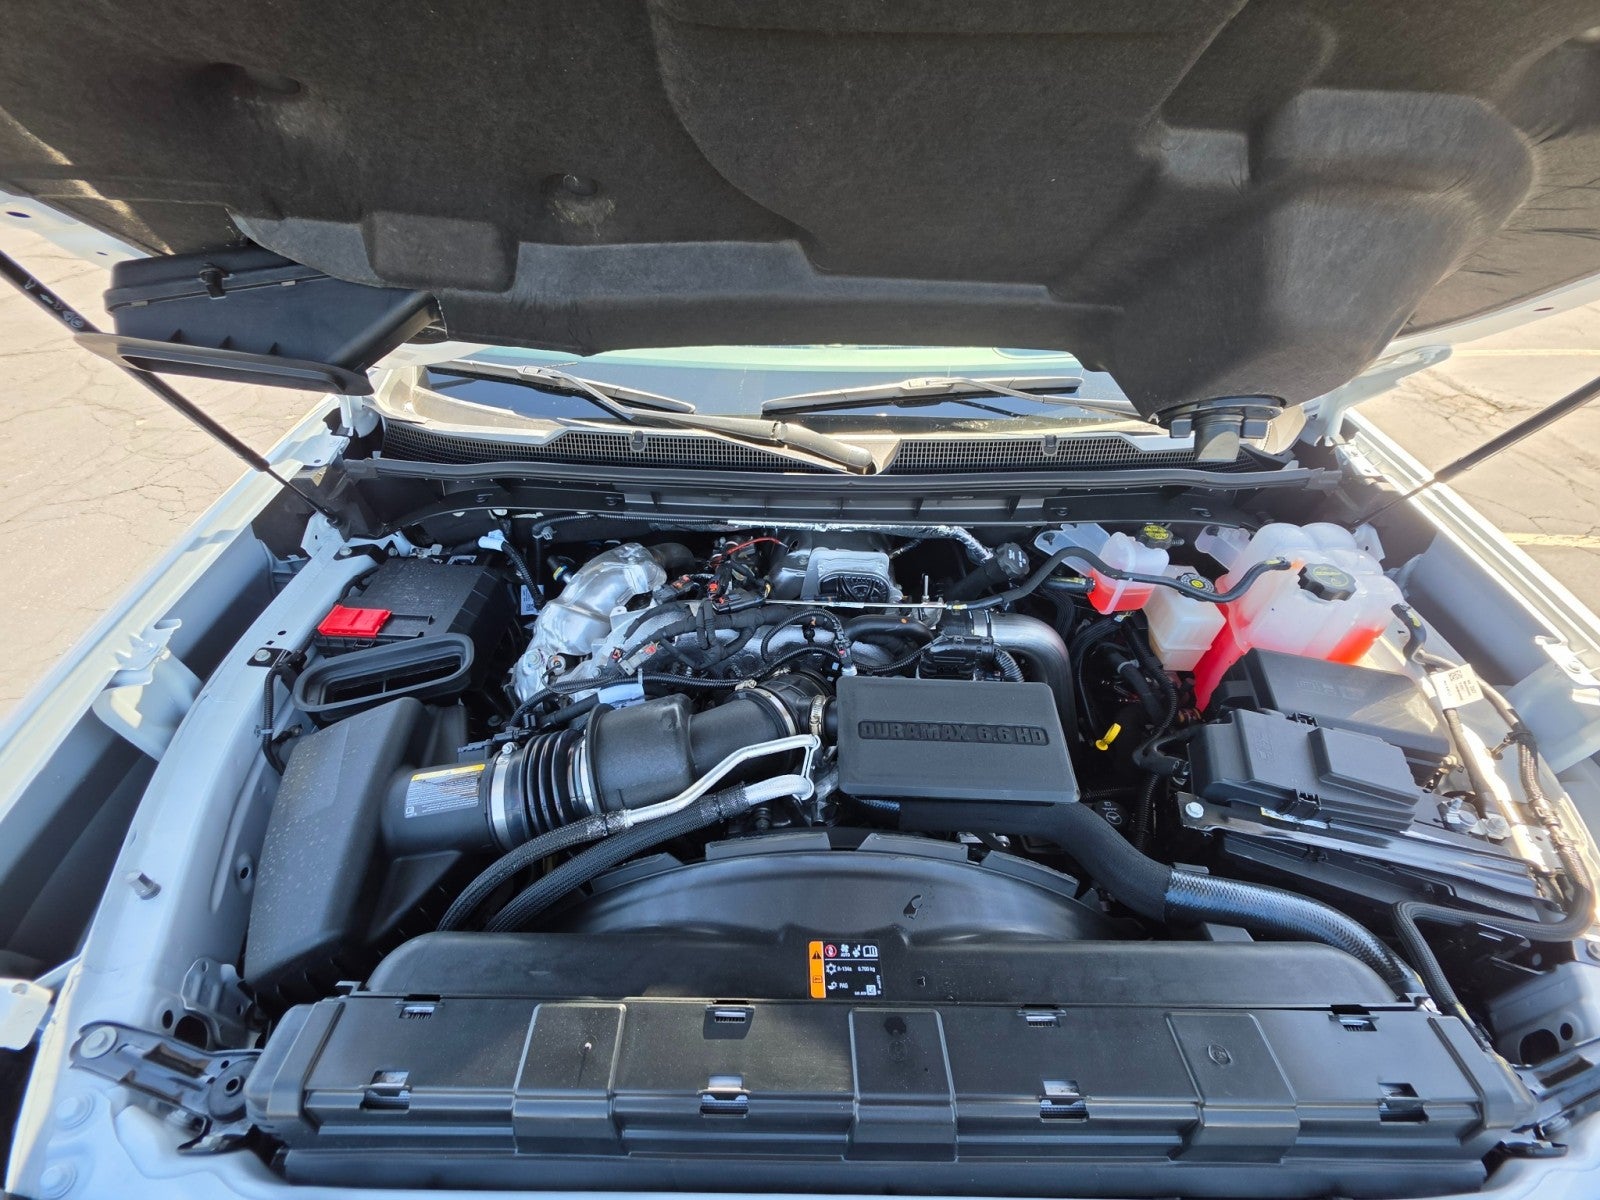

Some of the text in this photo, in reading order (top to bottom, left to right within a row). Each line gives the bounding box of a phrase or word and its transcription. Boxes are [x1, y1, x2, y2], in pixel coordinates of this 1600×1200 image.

[861, 721, 1047, 744] DURAMAX 6.6 HD
